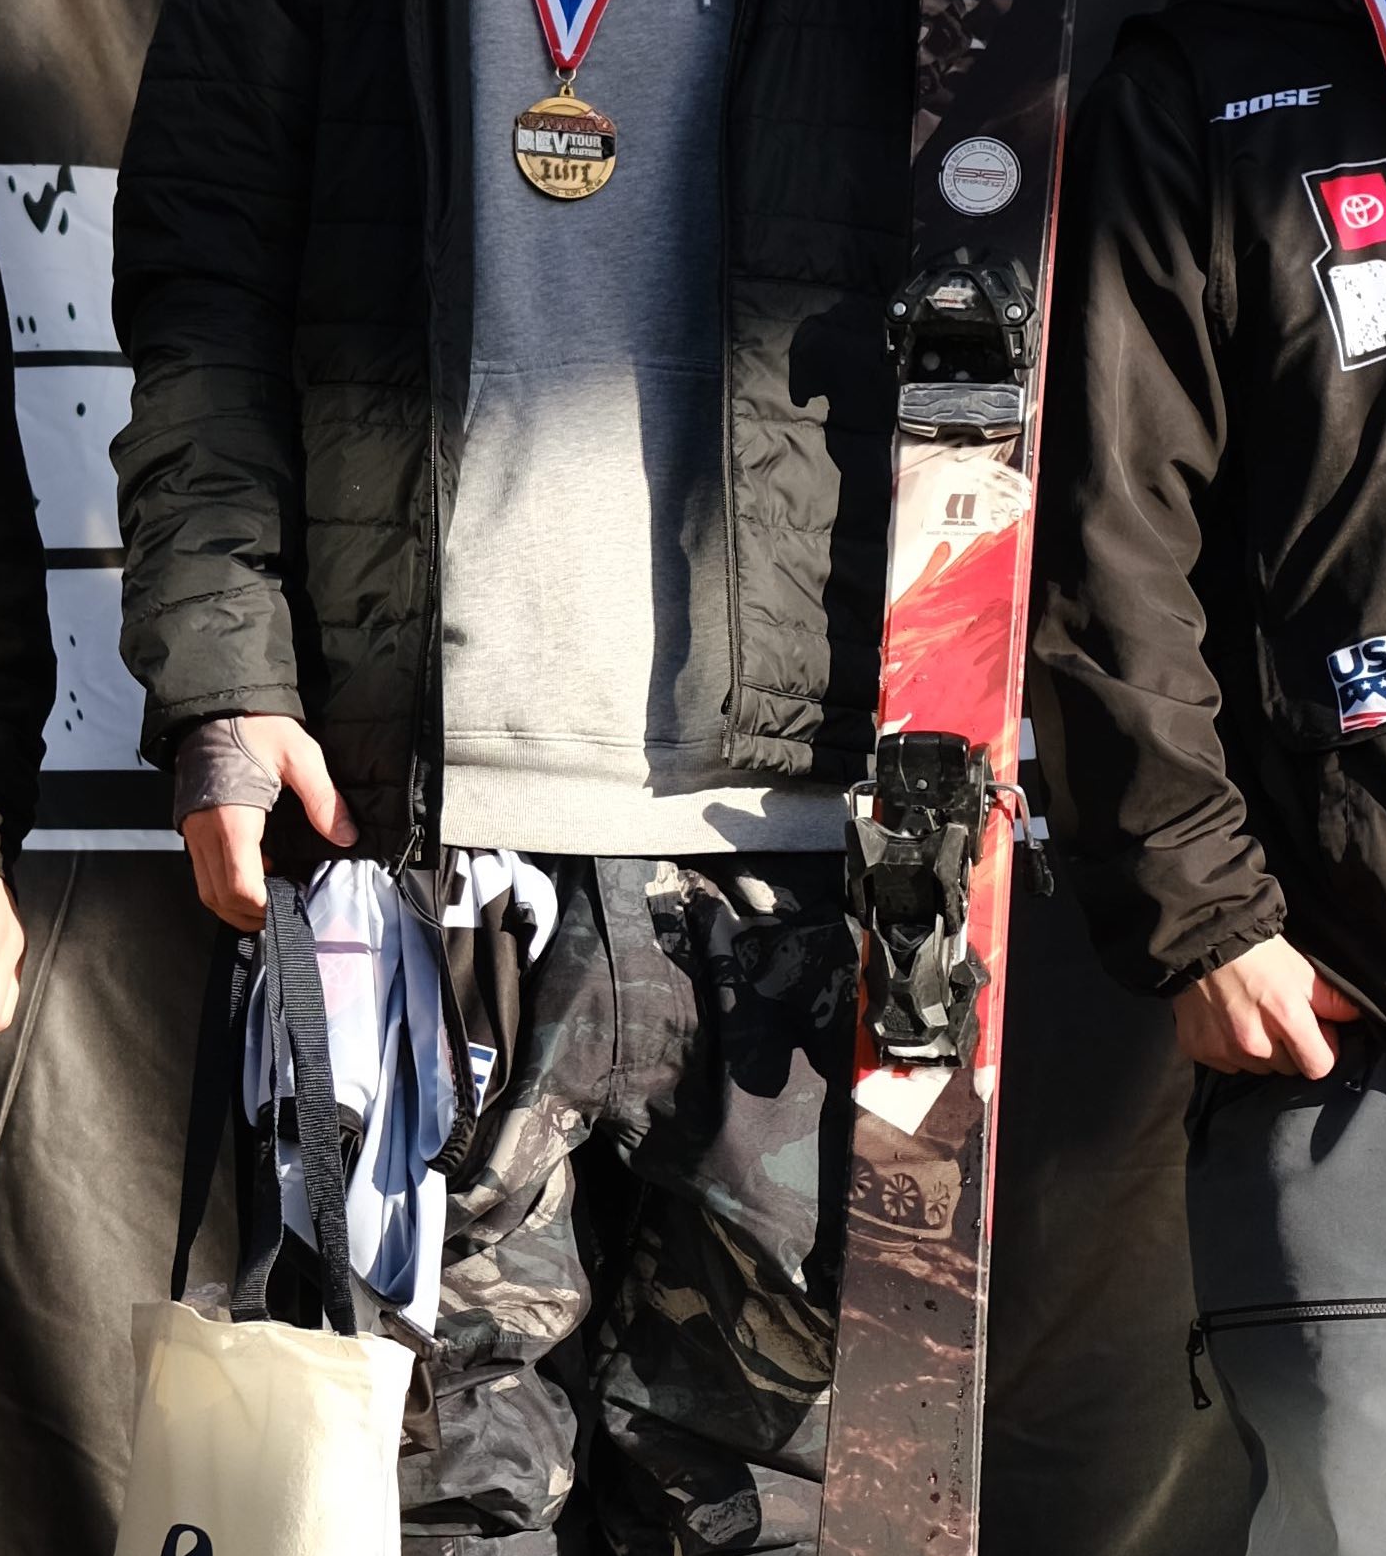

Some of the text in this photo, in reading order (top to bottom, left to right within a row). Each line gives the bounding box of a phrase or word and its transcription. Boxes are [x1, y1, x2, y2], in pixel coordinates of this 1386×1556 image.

[1210, 83, 1333, 123] BOSE
[569, 133, 602, 147] TOUR
[979, 140, 1000, 151] THAN
